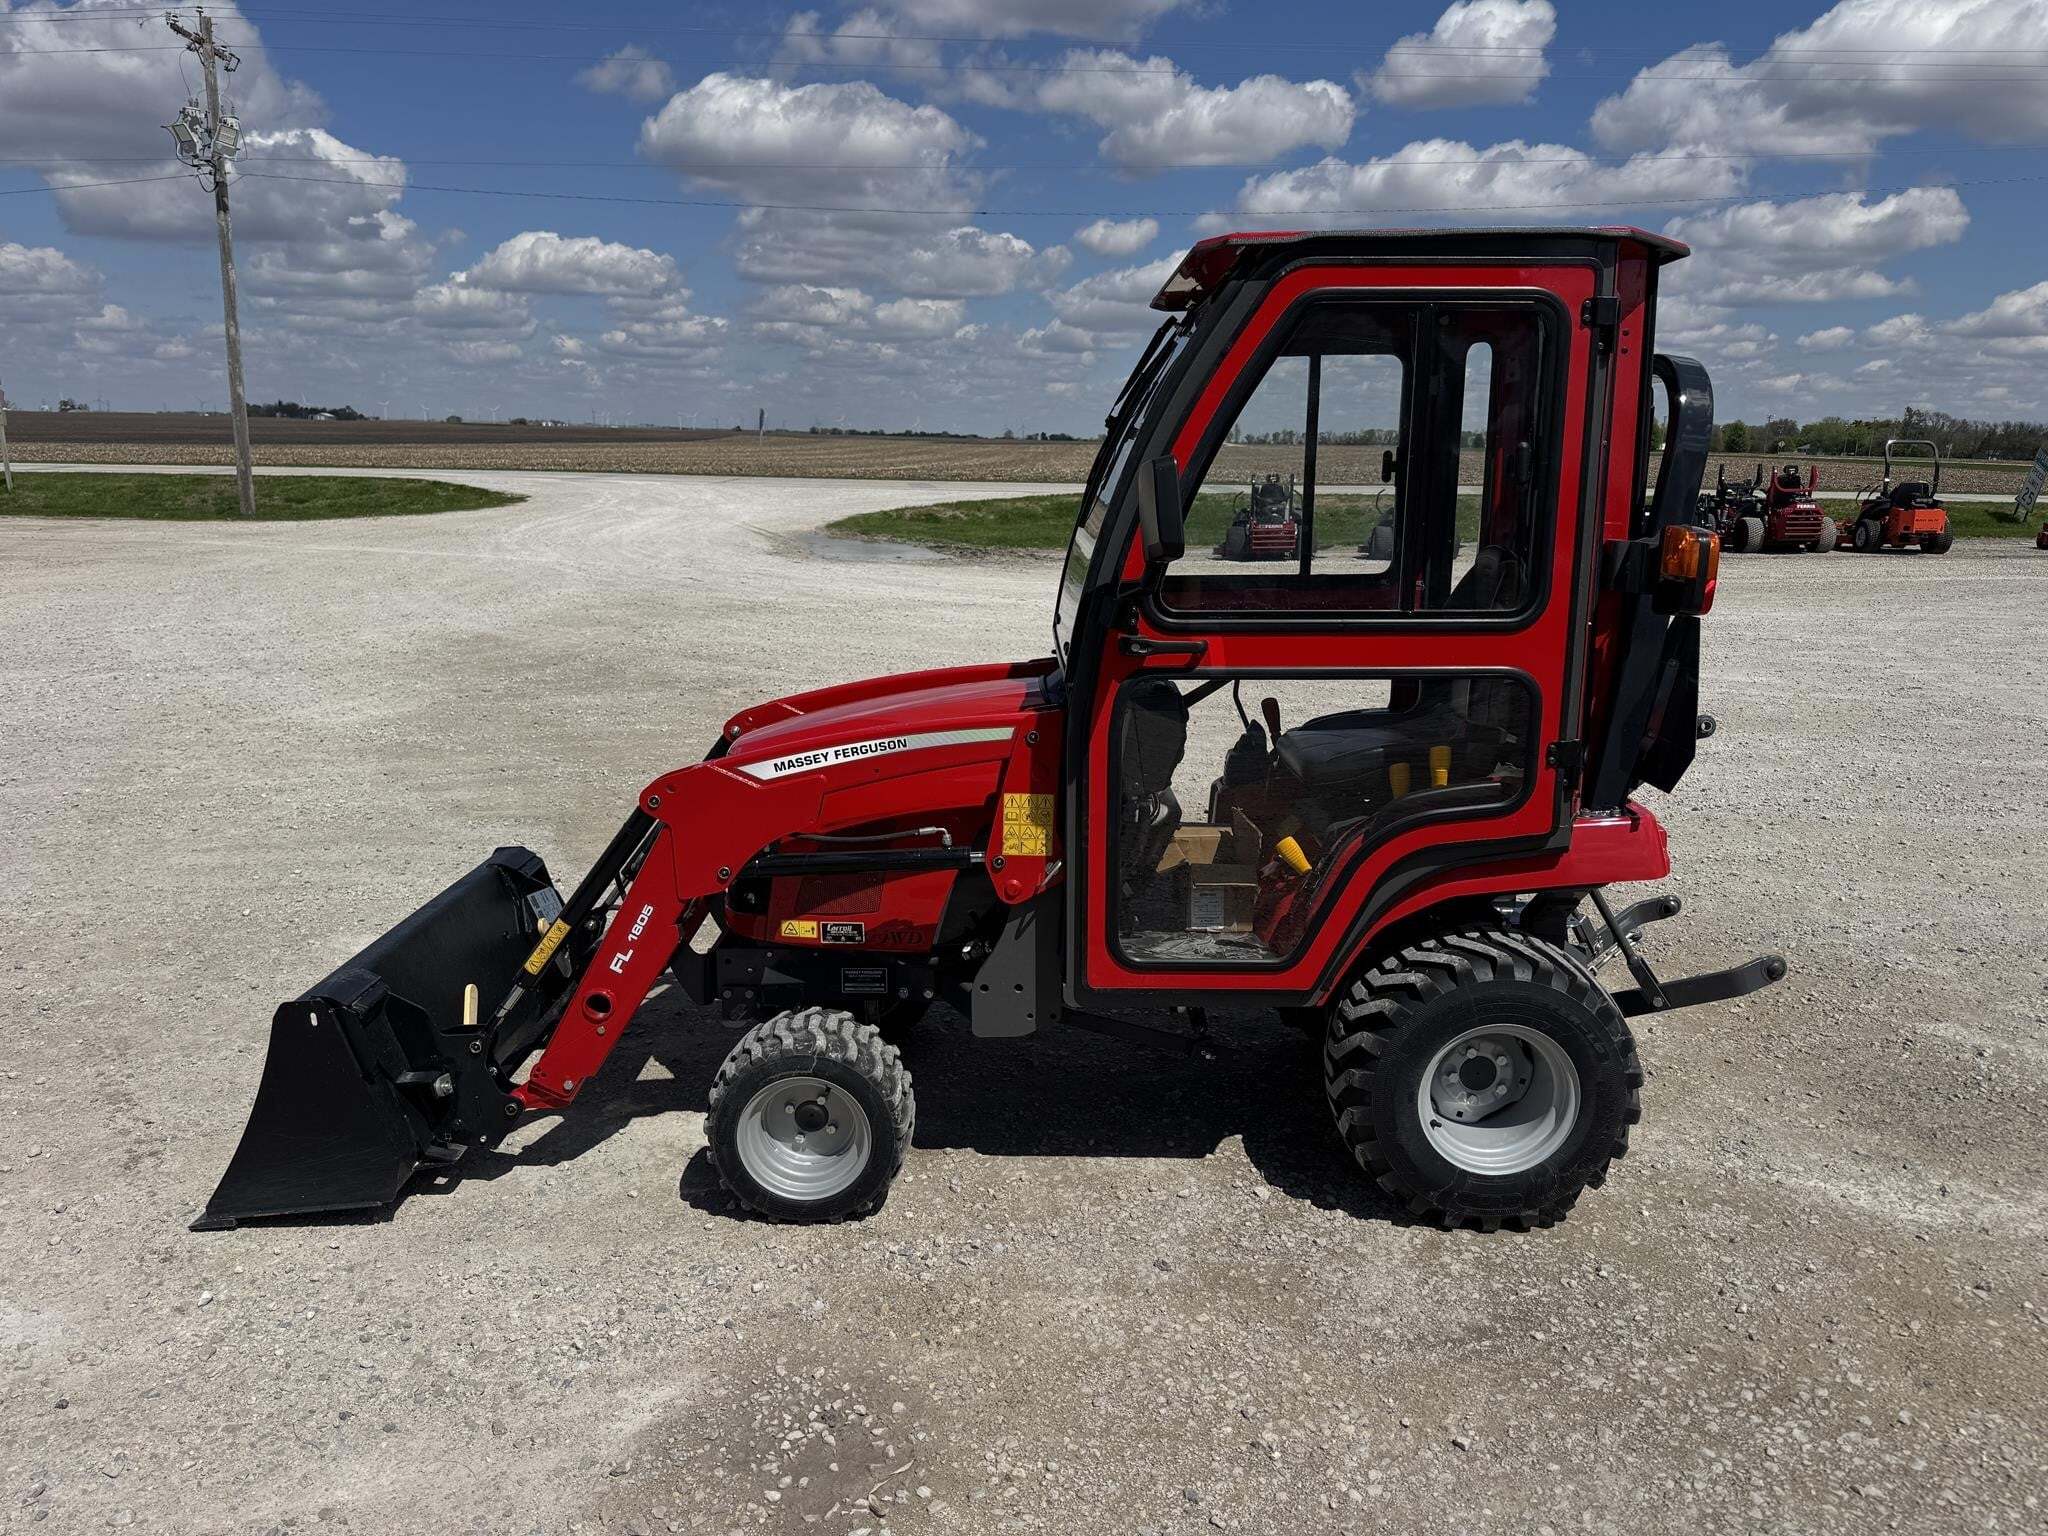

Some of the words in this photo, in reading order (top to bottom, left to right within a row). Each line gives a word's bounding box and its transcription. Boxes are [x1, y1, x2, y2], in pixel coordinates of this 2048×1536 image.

[2021, 487, 2035, 506] 25
[773, 751, 830, 773] MASSEY
[833, 738, 907, 760] FERGUSON
[609, 948, 634, 974] FL
[628, 903, 654, 942] 1805
